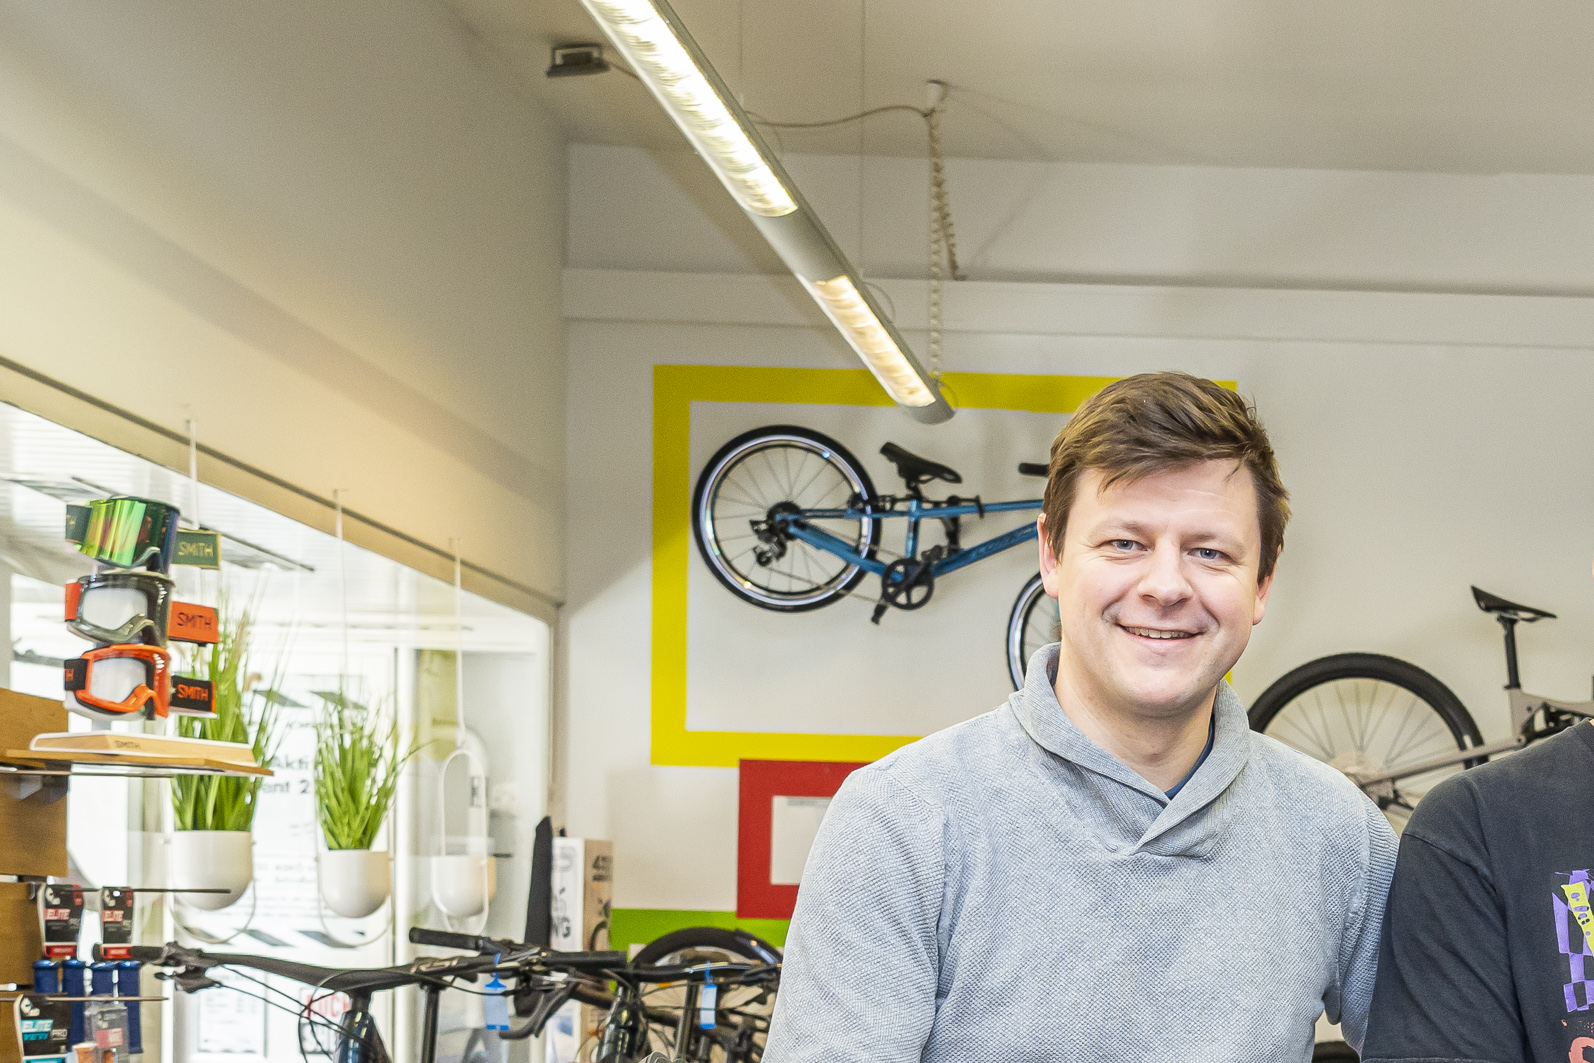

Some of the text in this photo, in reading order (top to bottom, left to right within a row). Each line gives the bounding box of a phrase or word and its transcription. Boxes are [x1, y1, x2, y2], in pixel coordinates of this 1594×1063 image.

[178, 541, 214, 558] SMITH
[177, 611, 213, 631] SMITH
[176, 683, 209, 701] SMITH
[45, 908, 71, 921] ELITE
[102, 909, 124, 922] ELITE
[22, 1019, 53, 1033] ELITE
